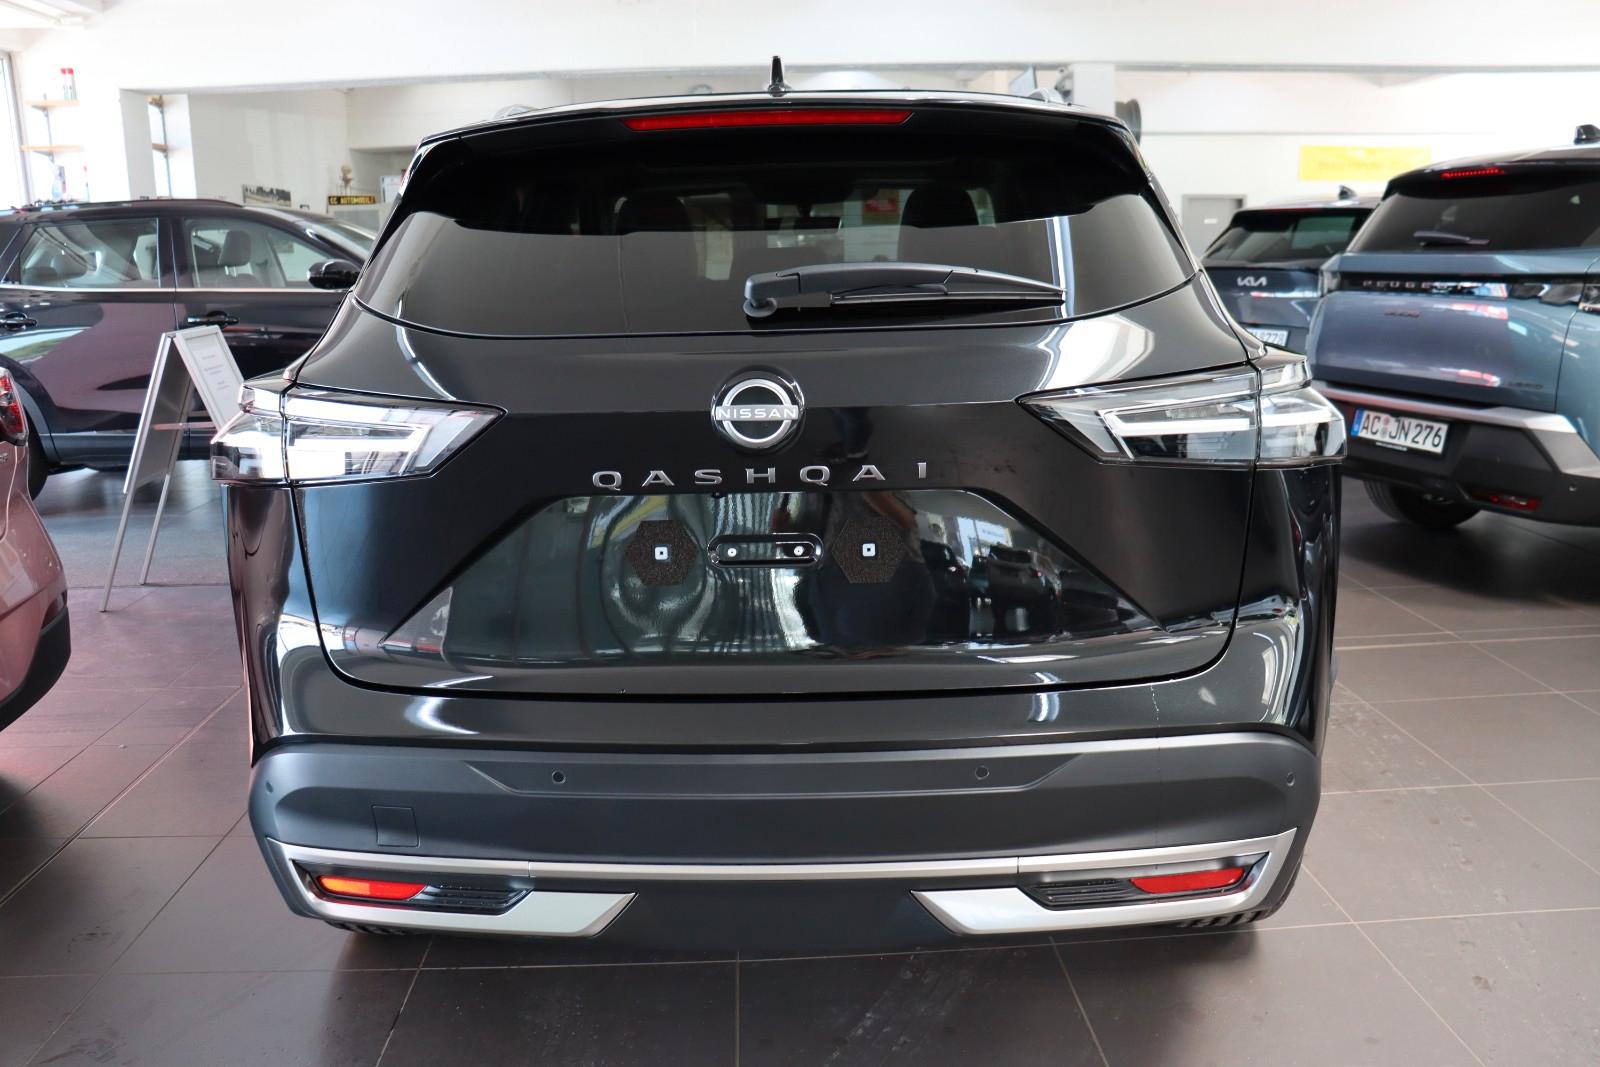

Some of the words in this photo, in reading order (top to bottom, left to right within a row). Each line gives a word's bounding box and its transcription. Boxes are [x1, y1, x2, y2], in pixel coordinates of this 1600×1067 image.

[1237, 276, 1268, 287] KIA
[718, 408, 797, 419] NISSAN
[1361, 414, 1381, 435] AC
[1389, 419, 1412, 442] JN
[1411, 423, 1442, 448] 276
[592, 462, 927, 491] QASHQAI
